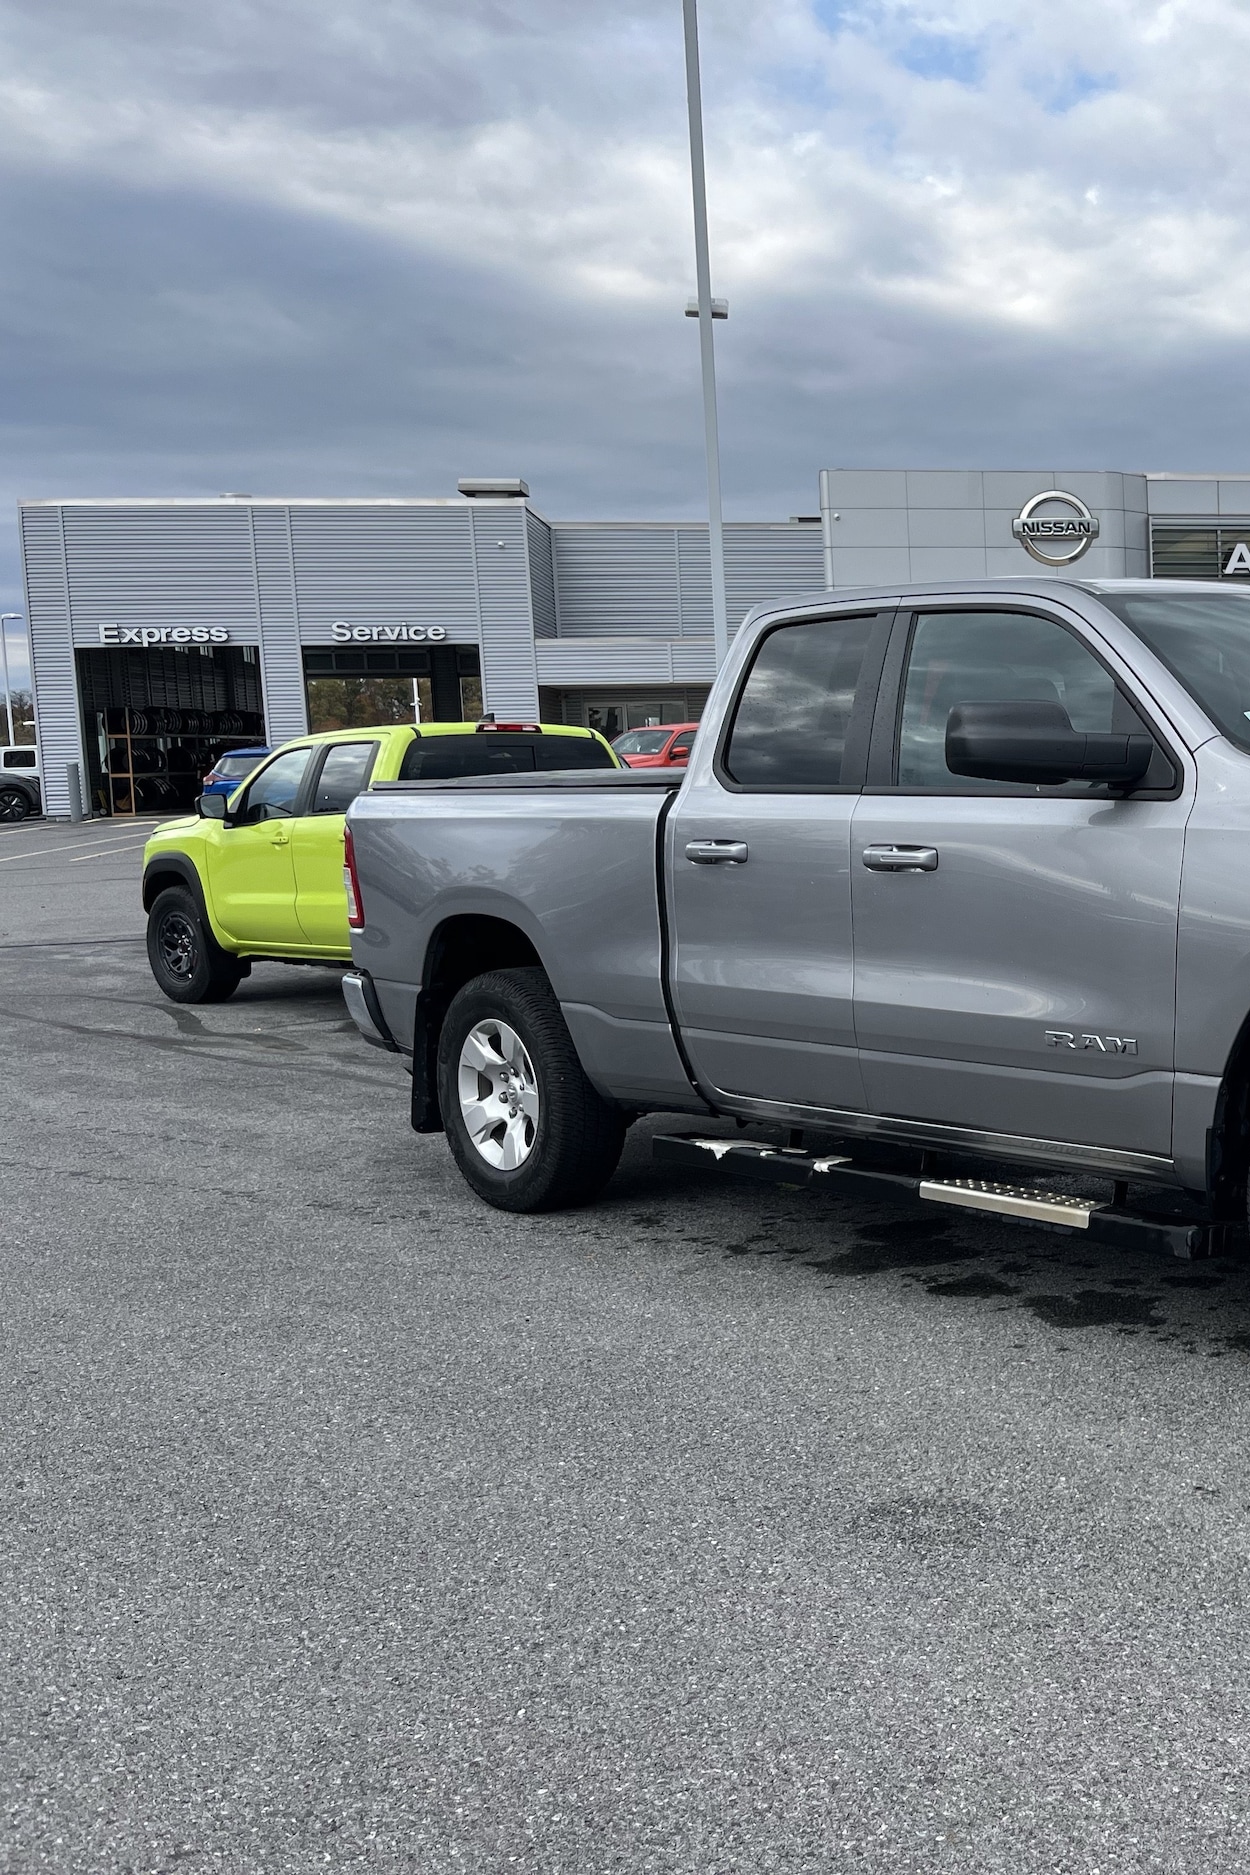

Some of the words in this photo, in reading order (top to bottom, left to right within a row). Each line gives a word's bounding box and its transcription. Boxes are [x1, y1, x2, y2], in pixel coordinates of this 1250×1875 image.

[1022, 522, 1091, 535] NISSAN
[98, 623, 229, 647] Express
[331, 621, 446, 642] Service
[1045, 1030, 1138, 1055] RAM
